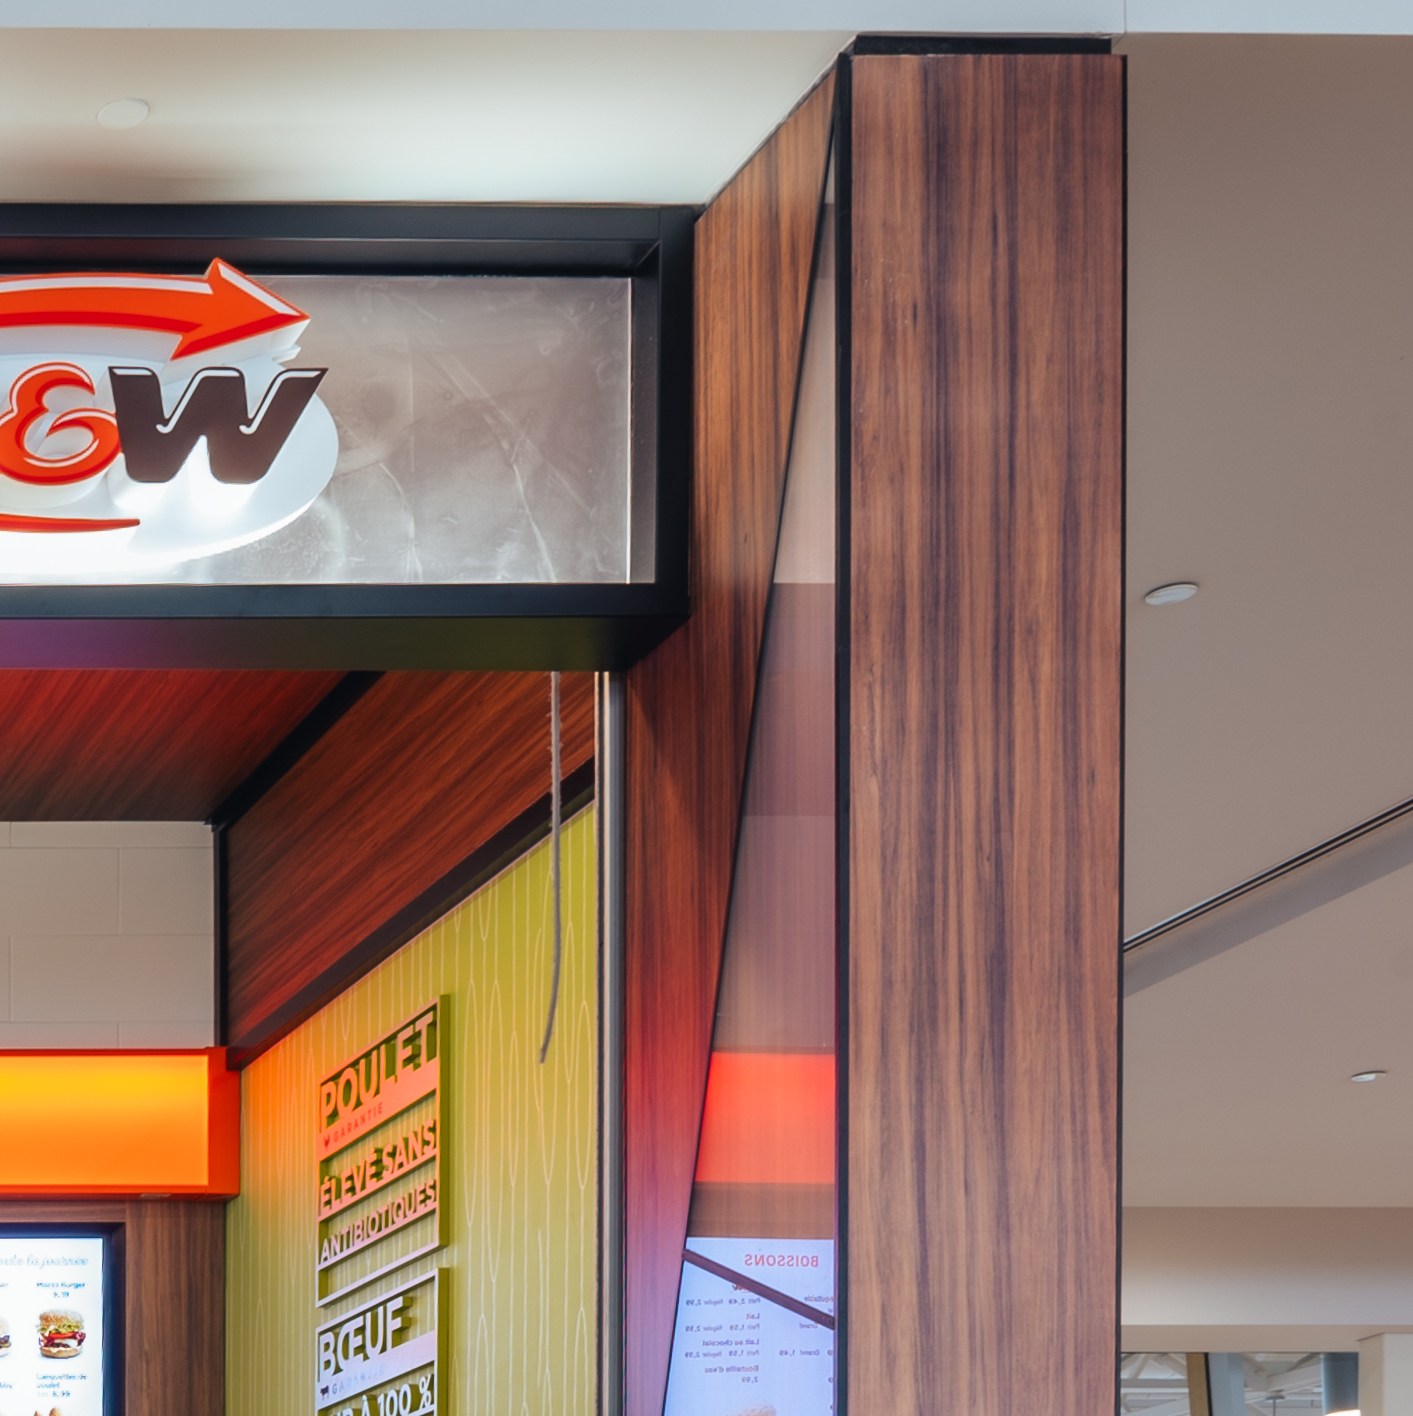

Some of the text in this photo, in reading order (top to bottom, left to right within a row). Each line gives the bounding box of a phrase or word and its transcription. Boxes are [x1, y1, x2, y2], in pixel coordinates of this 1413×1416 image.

[321, 1010, 435, 1133] POULET
[333, 1101, 384, 1143] GARANTIE
[320, 1118, 436, 1216] ÉLEVÉ SANS
[319, 1179, 436, 1266] ANTIBIOTIQUES
[319, 1295, 404, 1383] BŒUF
[332, 1361, 385, 1395] GARANTIE
[419, 1374, 432, 1410] %
